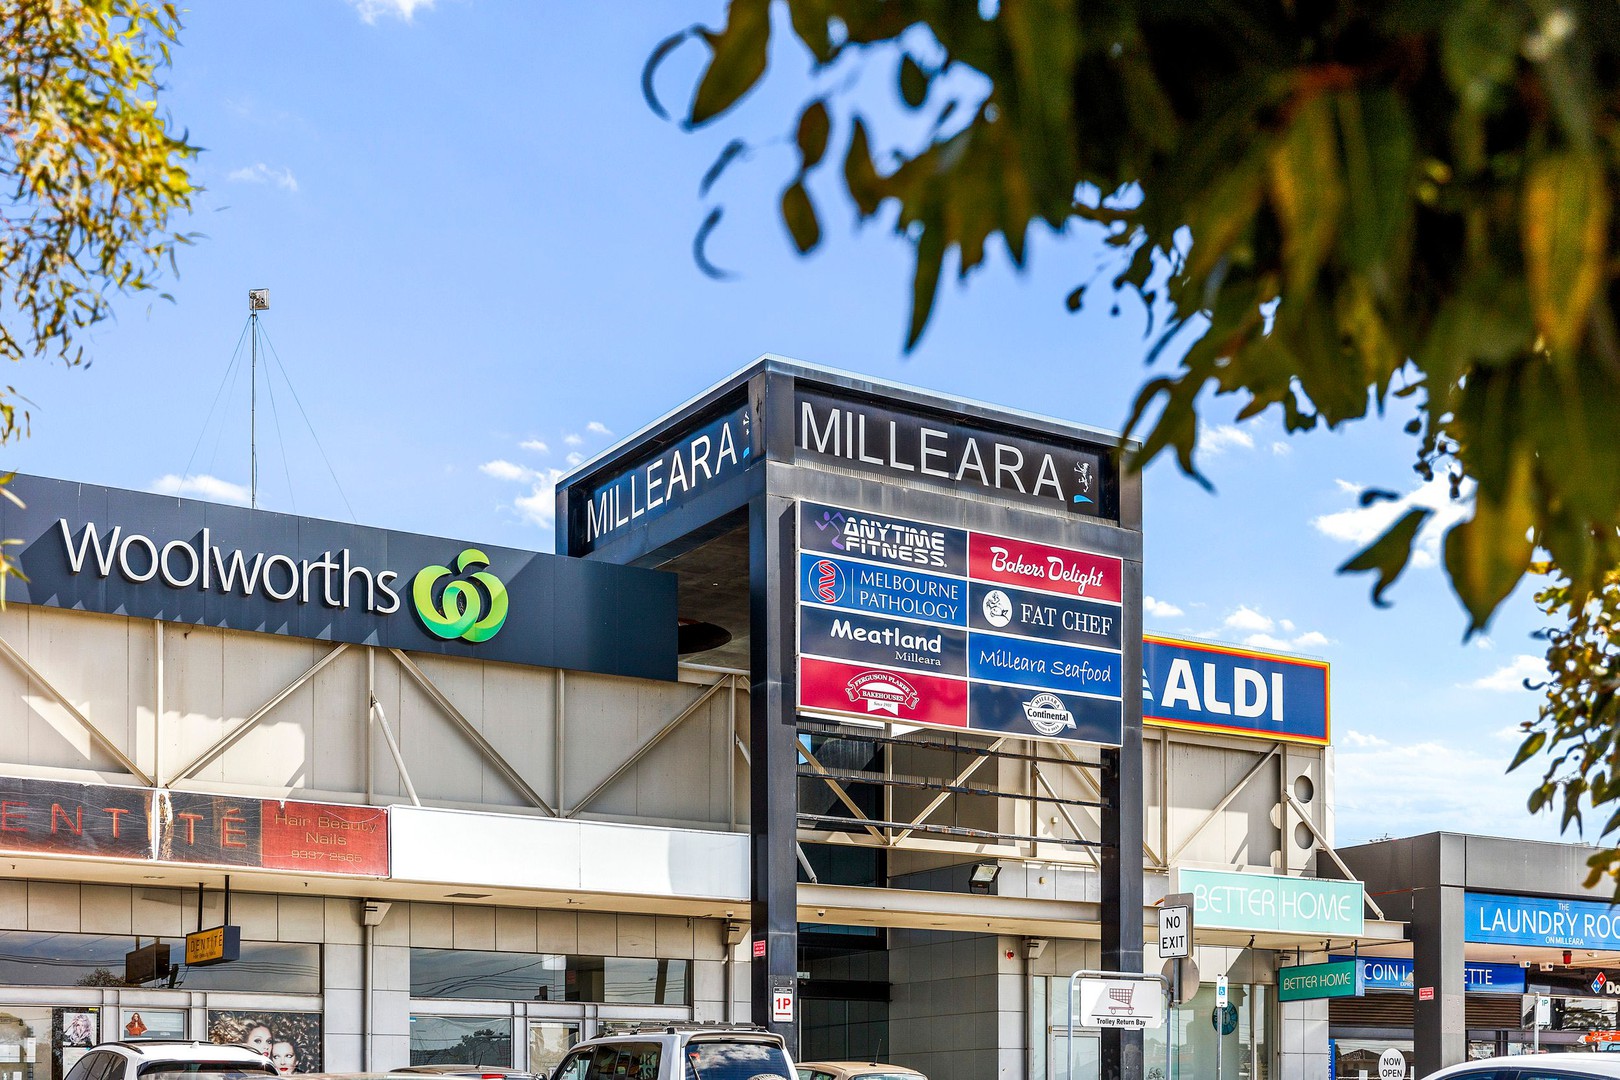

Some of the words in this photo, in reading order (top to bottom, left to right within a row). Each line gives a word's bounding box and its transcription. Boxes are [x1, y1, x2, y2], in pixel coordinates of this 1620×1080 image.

[801, 401, 1065, 502] MILLEARA
[586, 422, 737, 543] MILLEARA
[843, 517, 945, 551] ANYTIME
[60, 518, 401, 614] Woolworths
[990, 547, 1045, 578] Bakers
[1047, 556, 1103, 594] Delight
[860, 570, 958, 600] MELBOURNE
[860, 591, 958, 620] PATHOLOGY
[1020, 603, 1057, 627] FAT
[1062, 610, 1112, 635] CHEF
[830, 618, 942, 653] Meatland
[895, 651, 941, 666] Milleara
[980, 649, 1045, 673] Milleara
[1050, 660, 1111, 685] Seafood
[862, 690, 904, 701] BAKEHOUSES
[1161, 658, 1283, 722] ALDI
[1027, 708, 1069, 722] Continental
[274, 813, 311, 826] Hair
[318, 816, 377, 834] Beauty
[305, 832, 347, 845] Nails
[1194, 883, 1275, 917] BETTER
[1282, 890, 1351, 921] HOME
[1557, 902, 1570, 911] THE
[1165, 915, 1181, 929] NO
[1480, 906, 1579, 936] LAUNDRY
[1162, 935, 1185, 949] EXIT
[1545, 936, 1555, 944] ON
[1556, 936, 1584, 946] MILLEARA
[1283, 974, 1318, 991] BETTER
[1319, 971, 1351, 987] HOME
[1364, 963, 1398, 981] COIN
[775, 997, 791, 1010] 1P
[1096, 1018, 1115, 1026] Trolley
[1116, 1018, 1135, 1026] Return
[1135, 1019, 1146, 1027] Bay
[1383, 1057, 1402, 1066] NOW
[1382, 1069, 1403, 1078] OPEN
